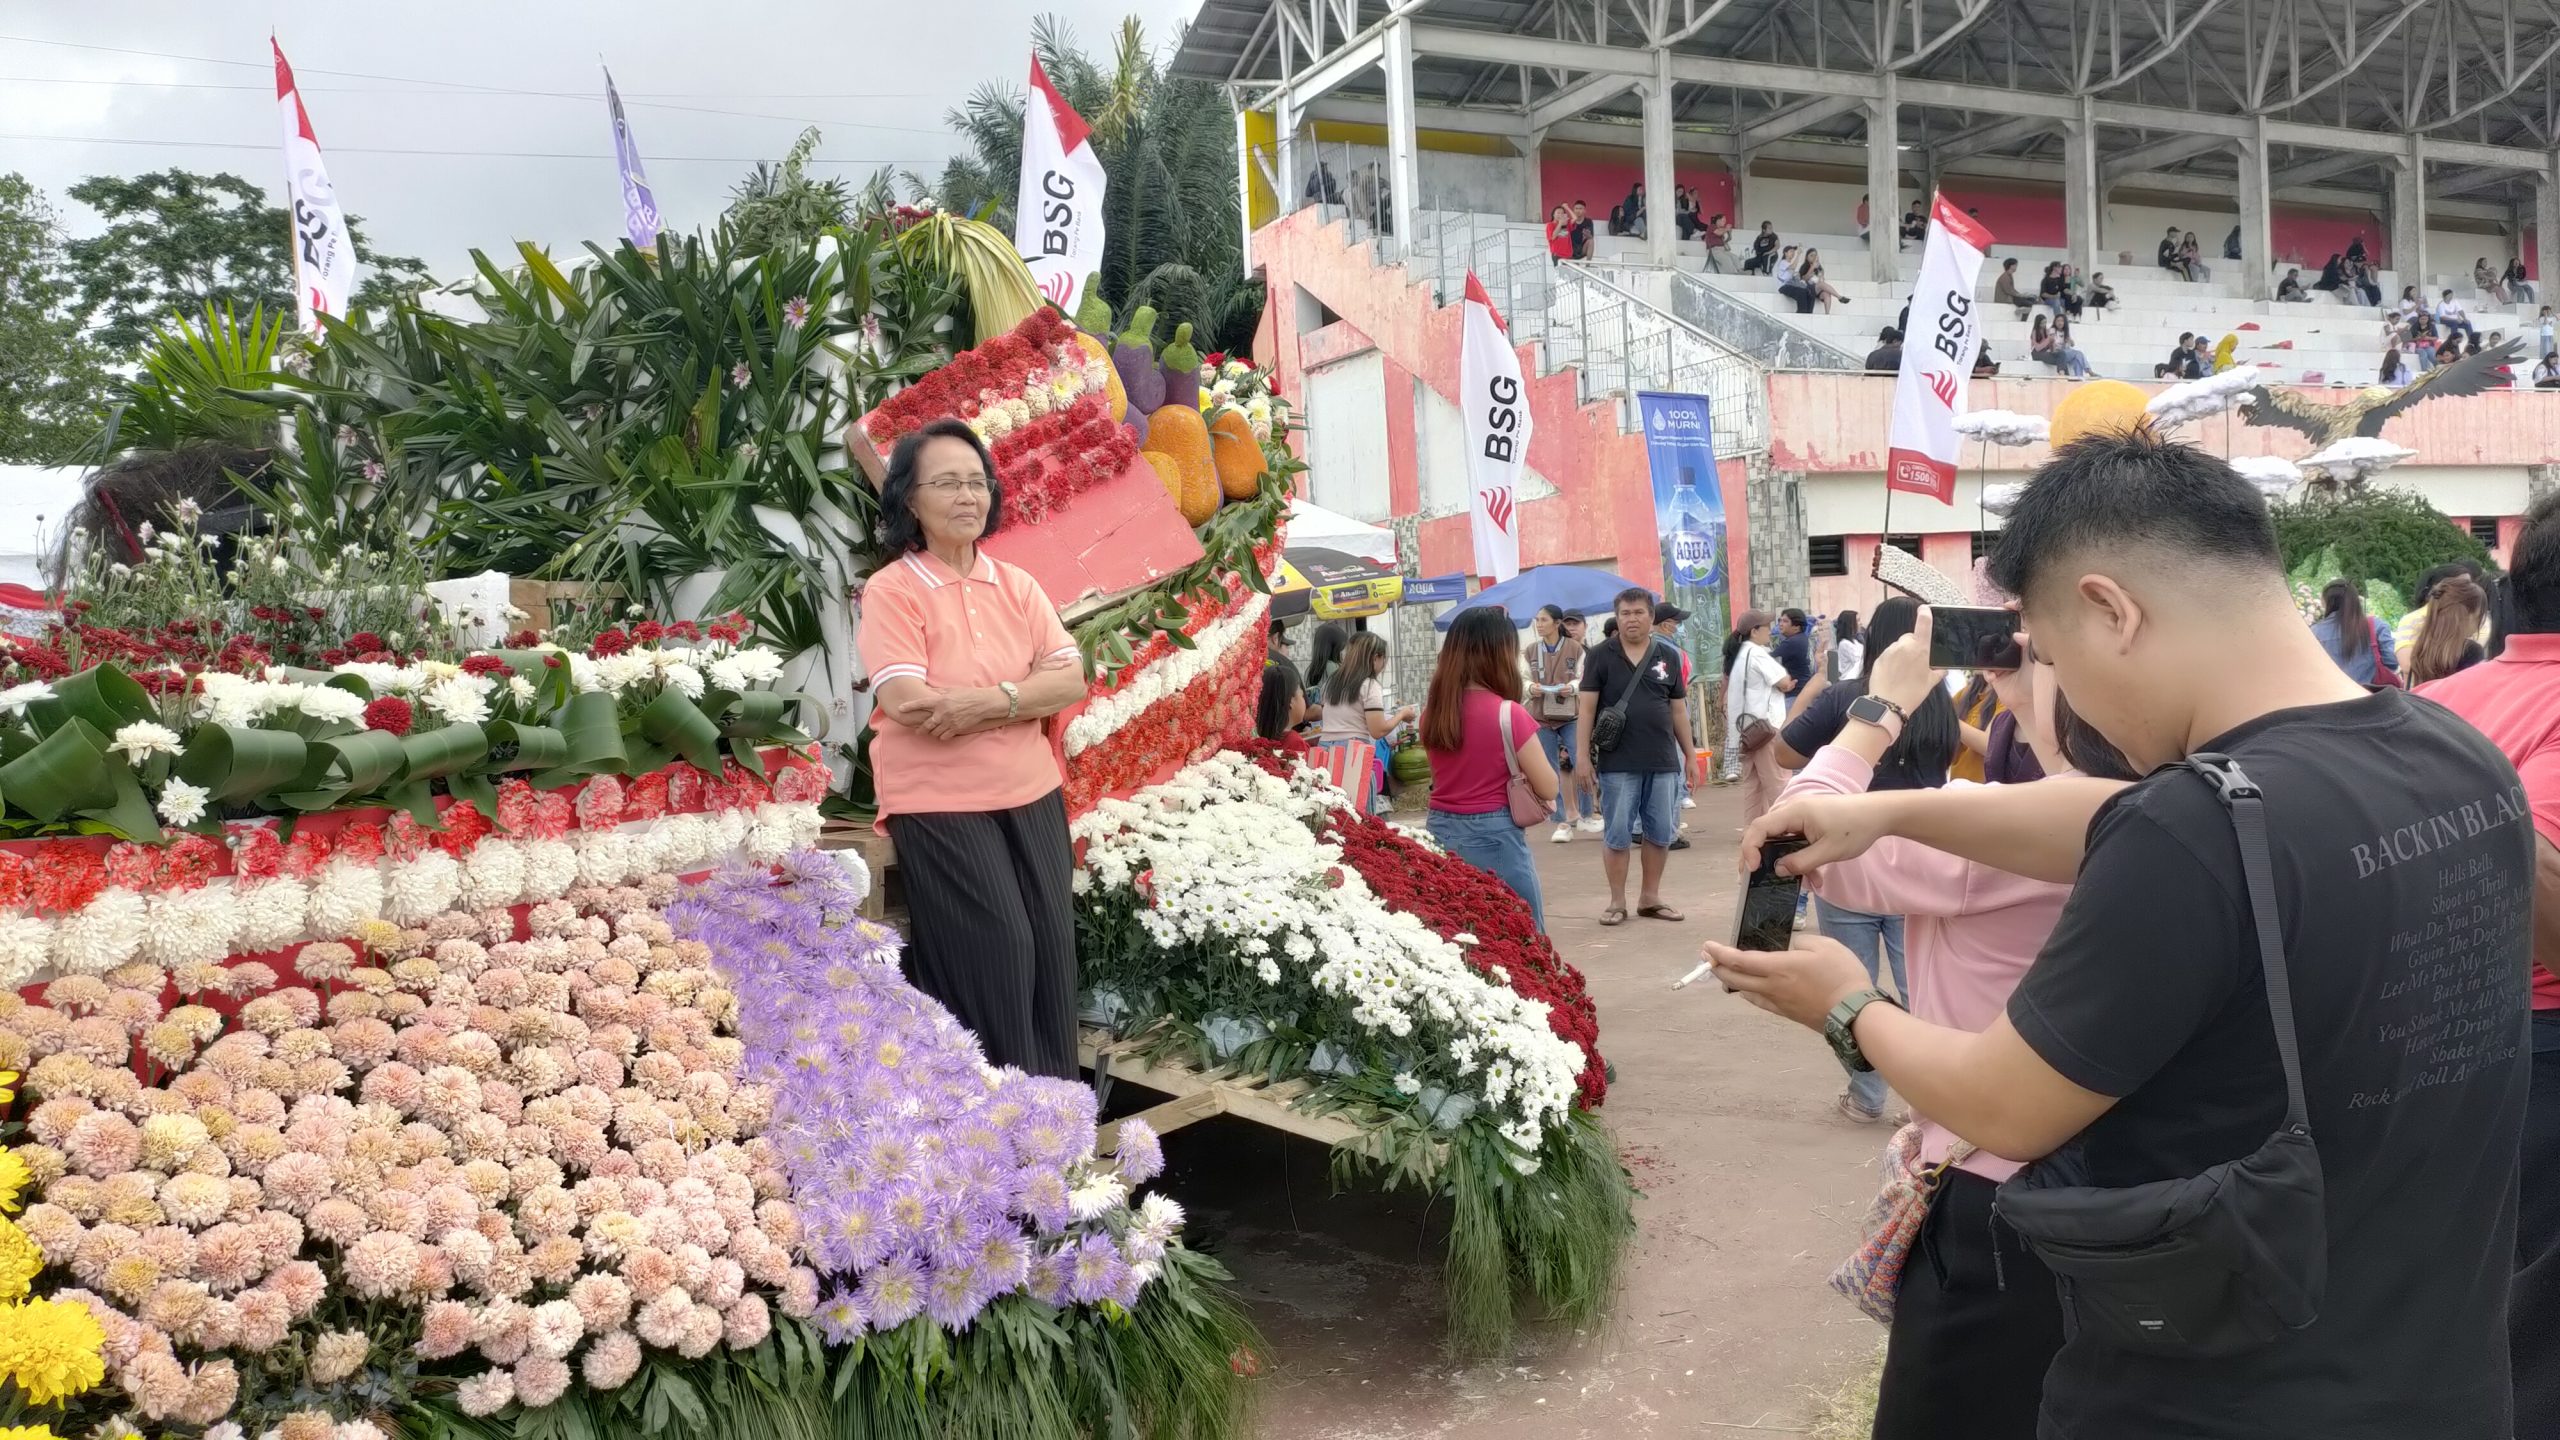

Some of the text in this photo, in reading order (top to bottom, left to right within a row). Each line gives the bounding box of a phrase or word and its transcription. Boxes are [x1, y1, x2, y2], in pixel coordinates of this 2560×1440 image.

[1043, 170, 1075, 256] BSG
[1935, 289, 1971, 362] BSG
[1484, 375, 1518, 463] BSG
[1667, 420, 1701, 430] MURNI
[1668, 410, 1697, 420] 100%
[1676, 541, 1713, 564] AQUA
[1409, 583, 1435, 595] AQUA
[2350, 783, 2529, 879] BACK IN BLAC
[2438, 853, 2494, 888] Hells Bells
[2431, 891, 2462, 914] Shoot
[2479, 869, 2508, 896] Thrill
[2389, 930, 2422, 952] What
[2426, 921, 2444, 941] Do
[2446, 913, 2469, 932] You
[2473, 905, 2490, 923] Do
[2472, 927, 2497, 946] Dog
[2408, 970, 2429, 991] Me
[2379, 1023, 2406, 1042] You
[2430, 1041, 2474, 1064] Shake
[2347, 1088, 2391, 1110] Rock
[2416, 1066, 2448, 1091] Roll
